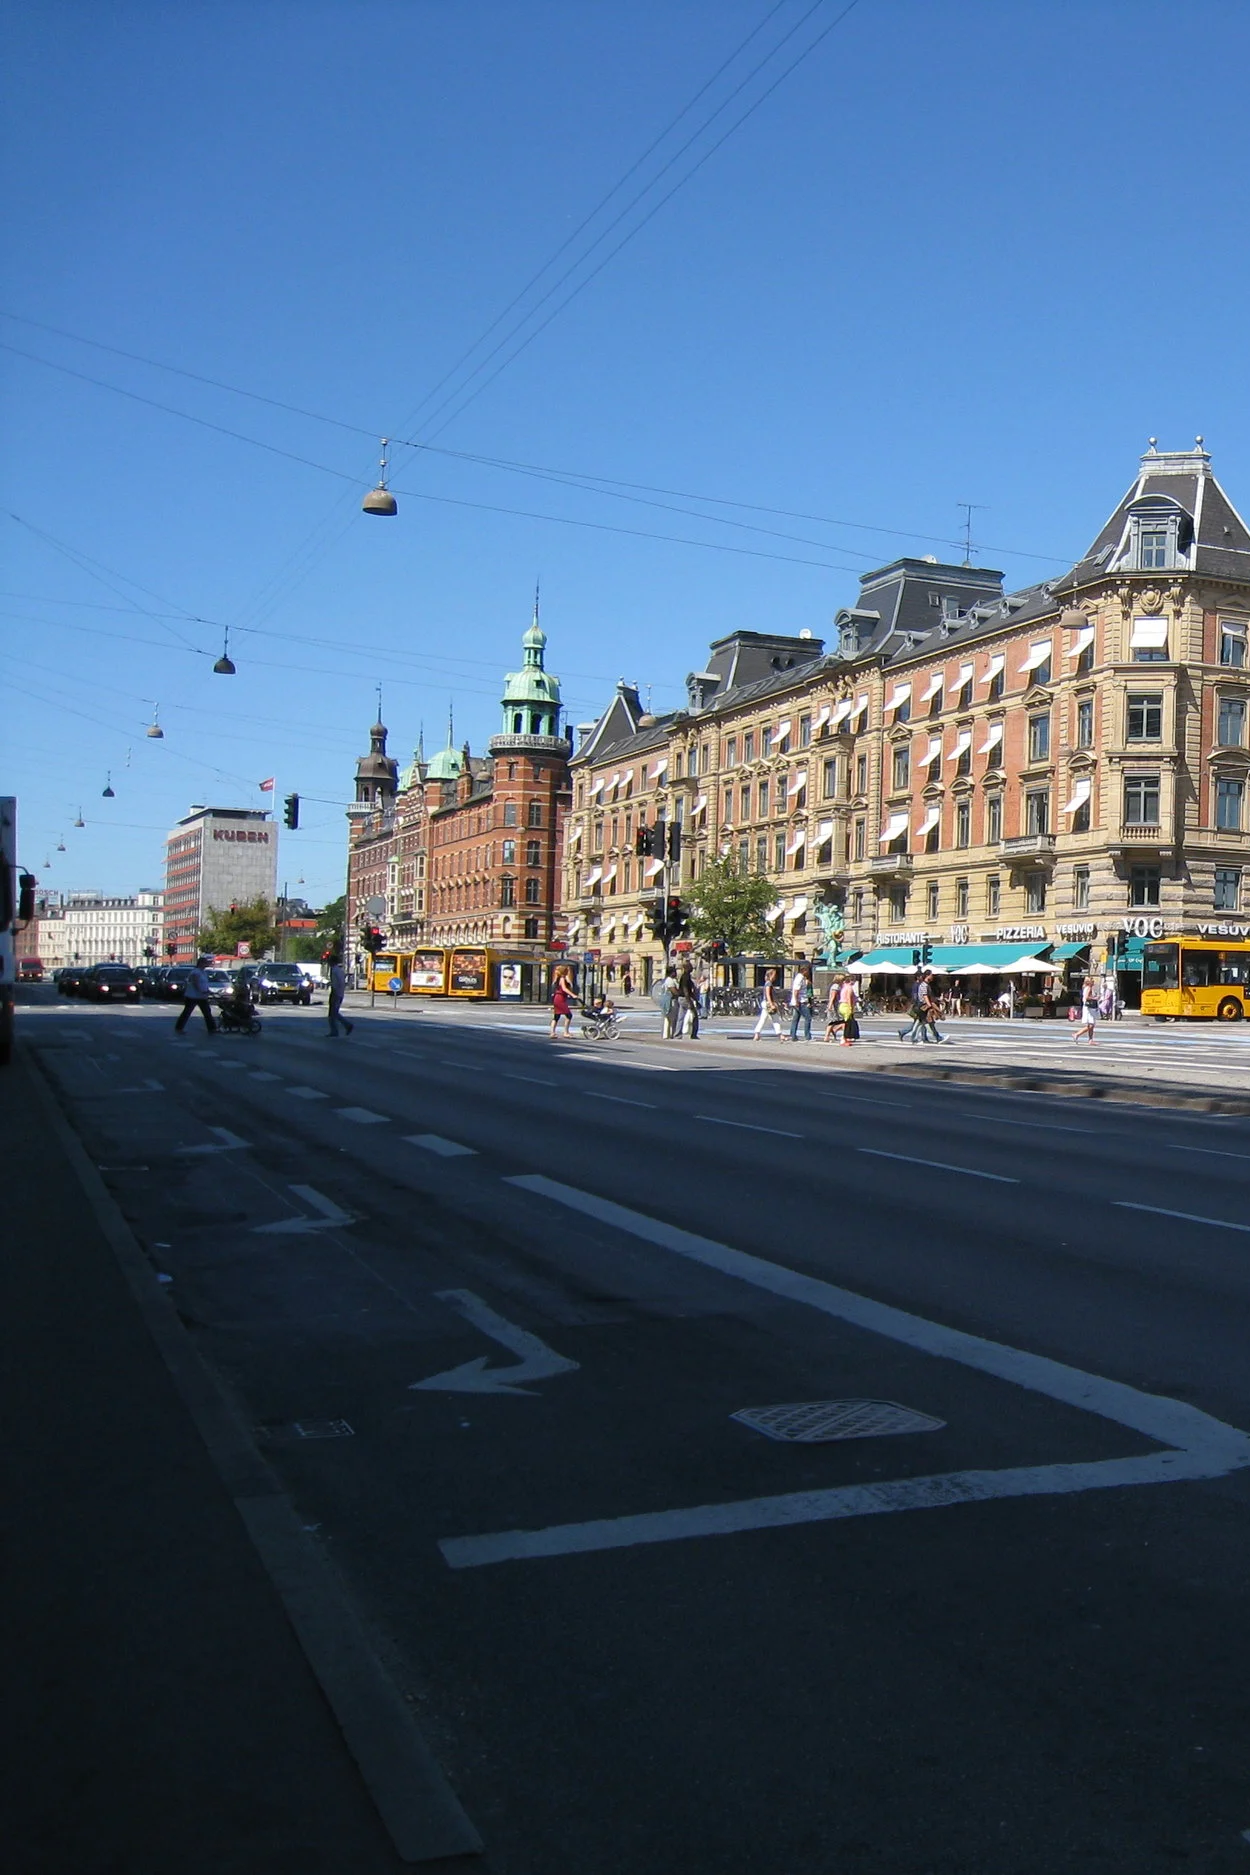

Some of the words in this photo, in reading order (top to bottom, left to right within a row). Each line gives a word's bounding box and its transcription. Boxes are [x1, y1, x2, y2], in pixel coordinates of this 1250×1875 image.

[213, 829, 269, 844] KUBEN
[951, 925, 968, 943] VOC
[996, 926, 1045, 940] PIZZERIA
[1056, 923, 1094, 934] VESUVIO
[1122, 917, 1163, 938] VOC
[876, 931, 926, 944] RISTORANTE
